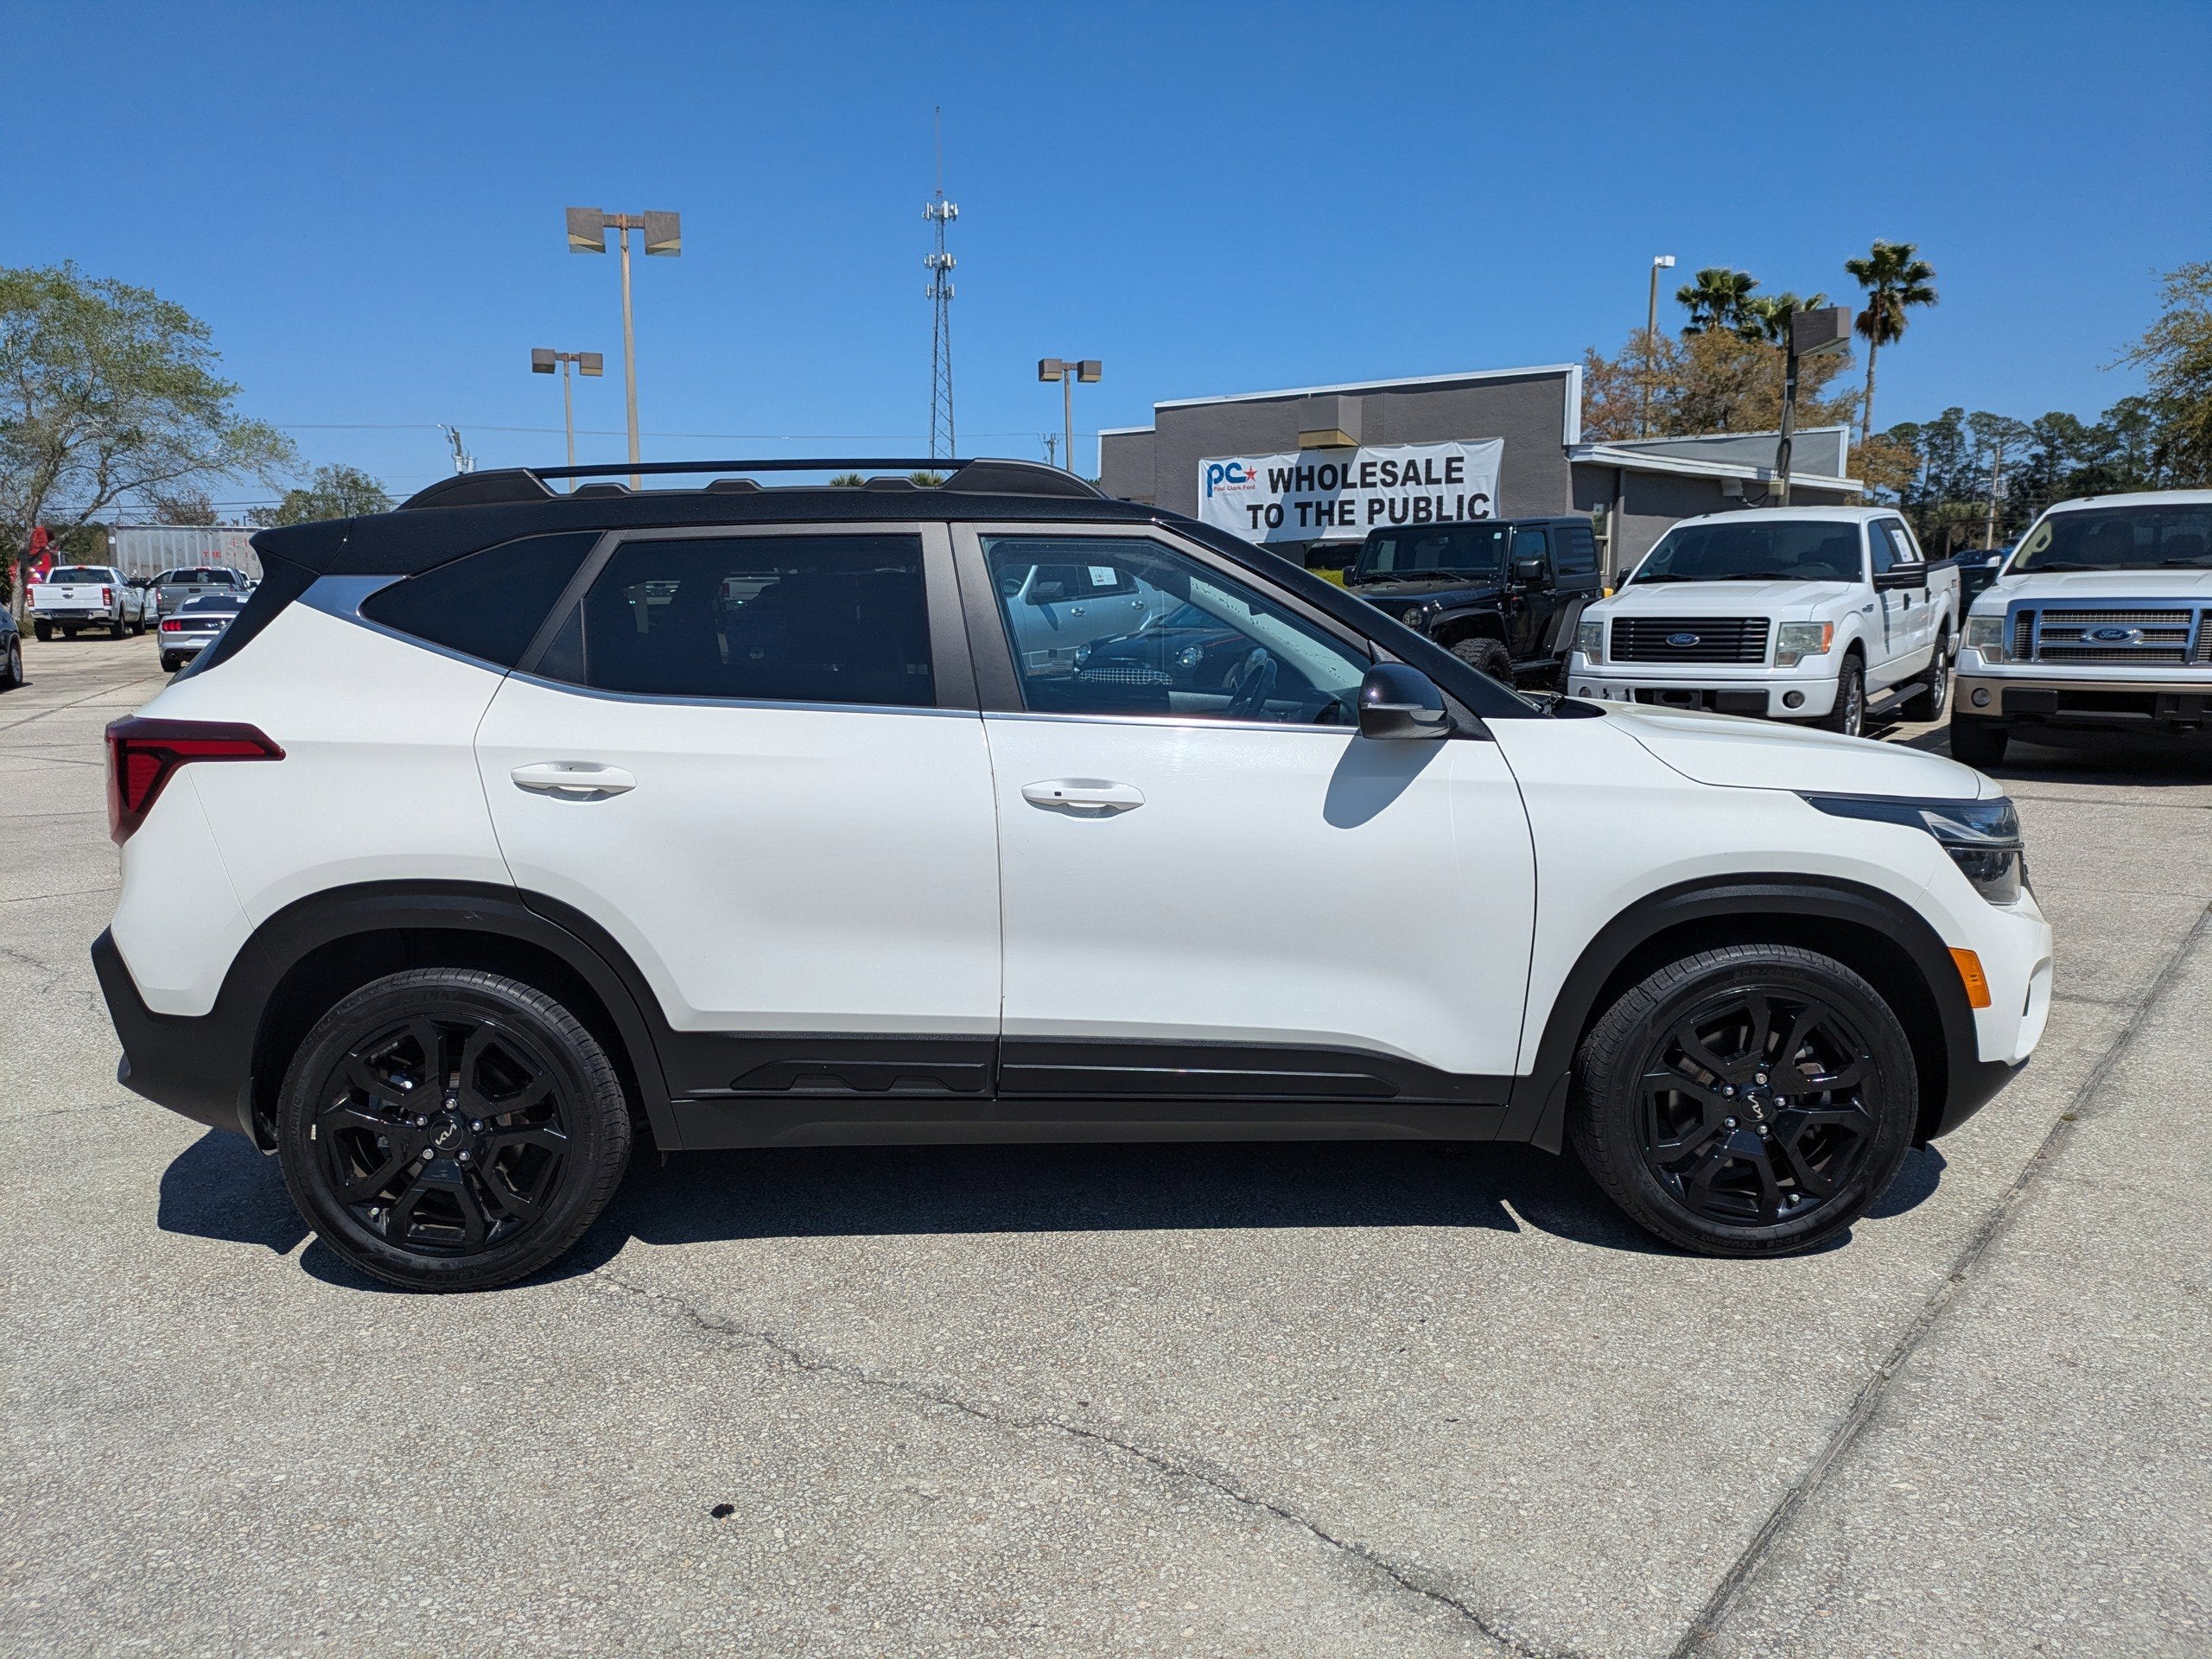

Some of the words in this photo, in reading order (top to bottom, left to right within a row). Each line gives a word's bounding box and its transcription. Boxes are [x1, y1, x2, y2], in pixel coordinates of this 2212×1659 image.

[1268, 456, 1465, 493] WHOLESALE
[1246, 503, 1284, 529] TO
[1294, 499, 1356, 527] THE
[1368, 493, 1490, 524] PUBLIC
